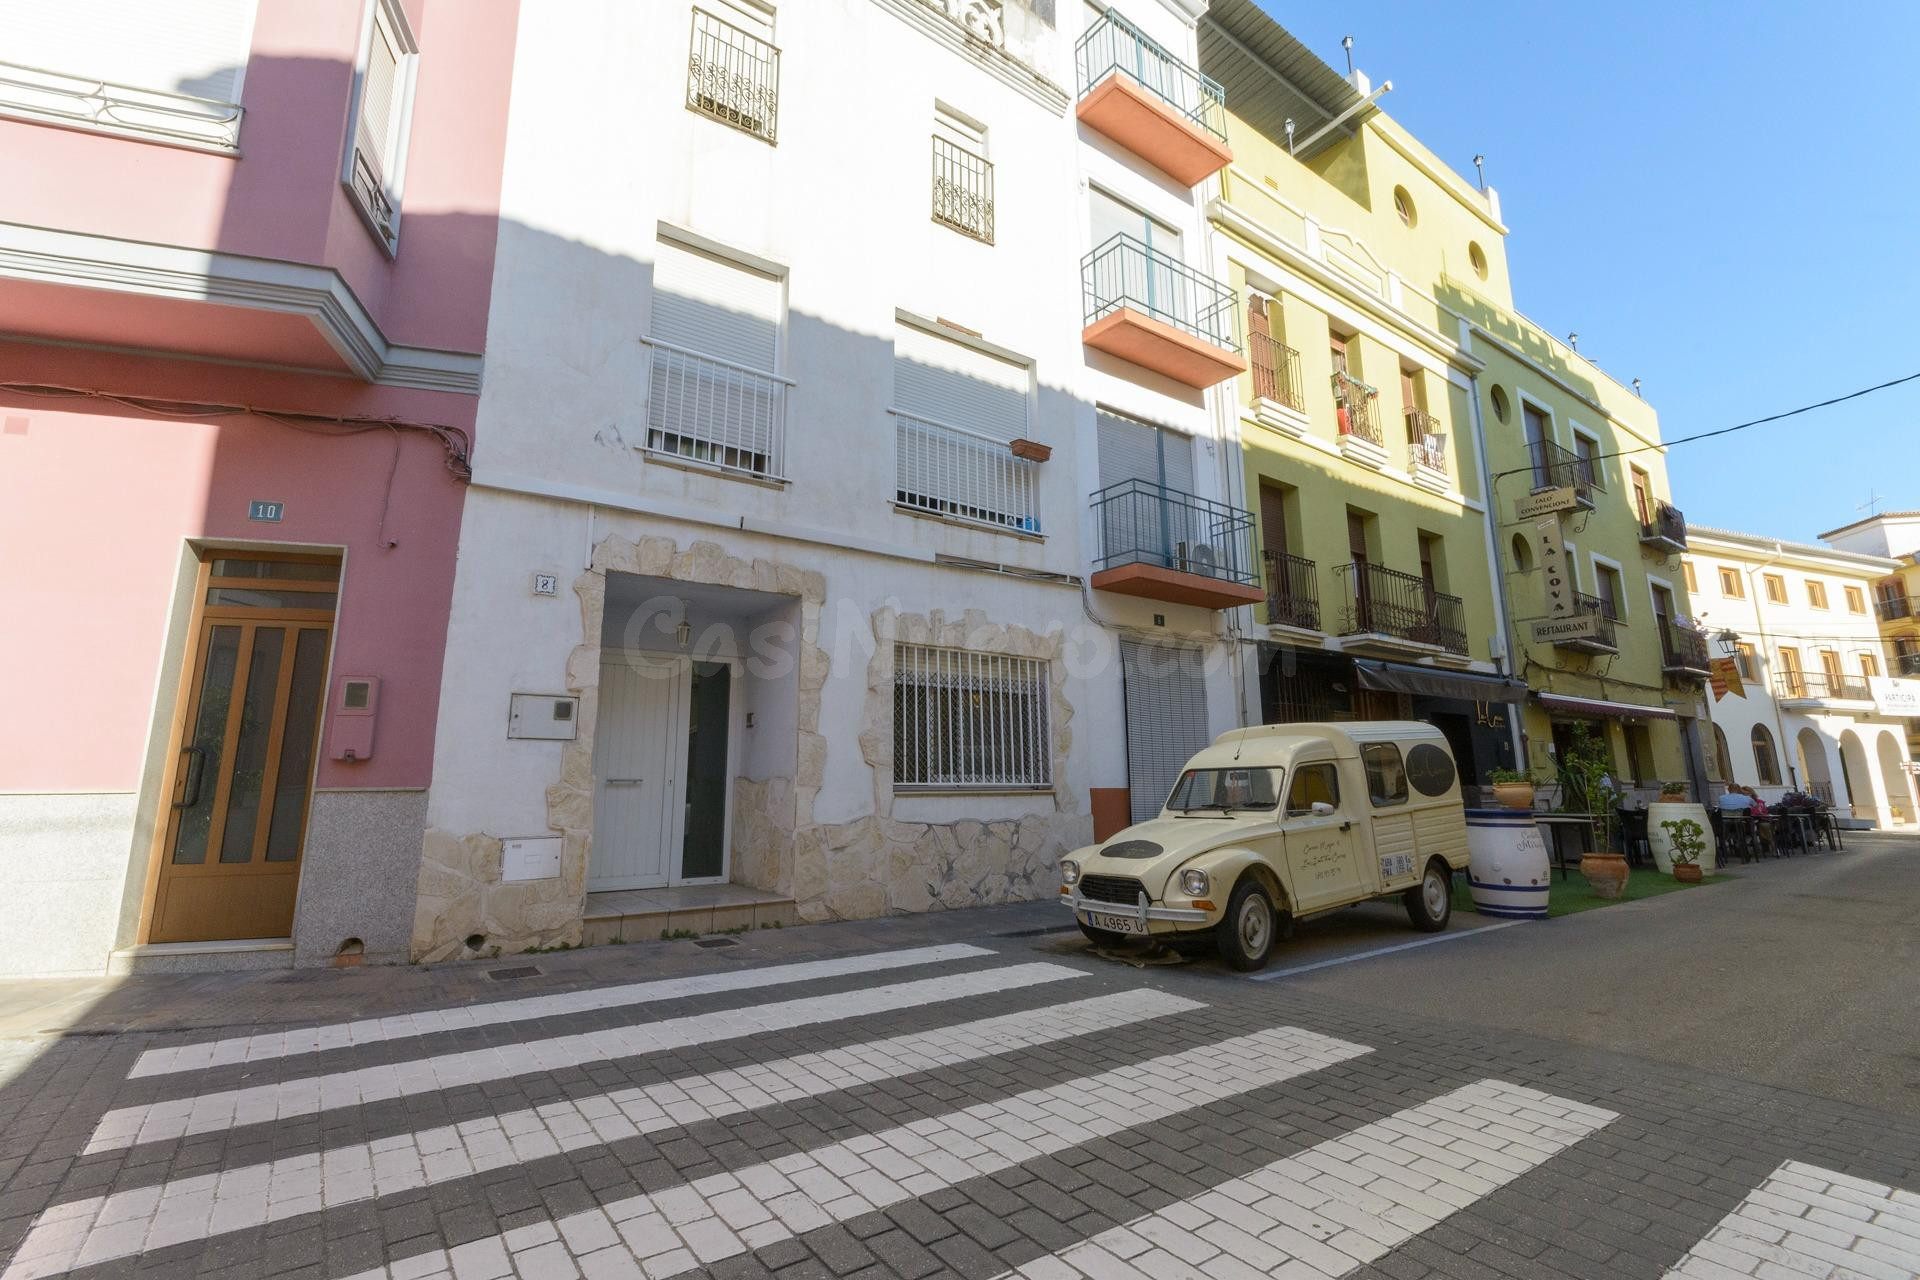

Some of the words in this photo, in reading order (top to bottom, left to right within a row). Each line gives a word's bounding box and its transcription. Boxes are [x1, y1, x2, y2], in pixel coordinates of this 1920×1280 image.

[257, 504, 276, 518] 10
[541, 579, 549, 590] 8
[1536, 622, 1588, 636] RESTAURANT
[1104, 917, 1131, 931] 4965
